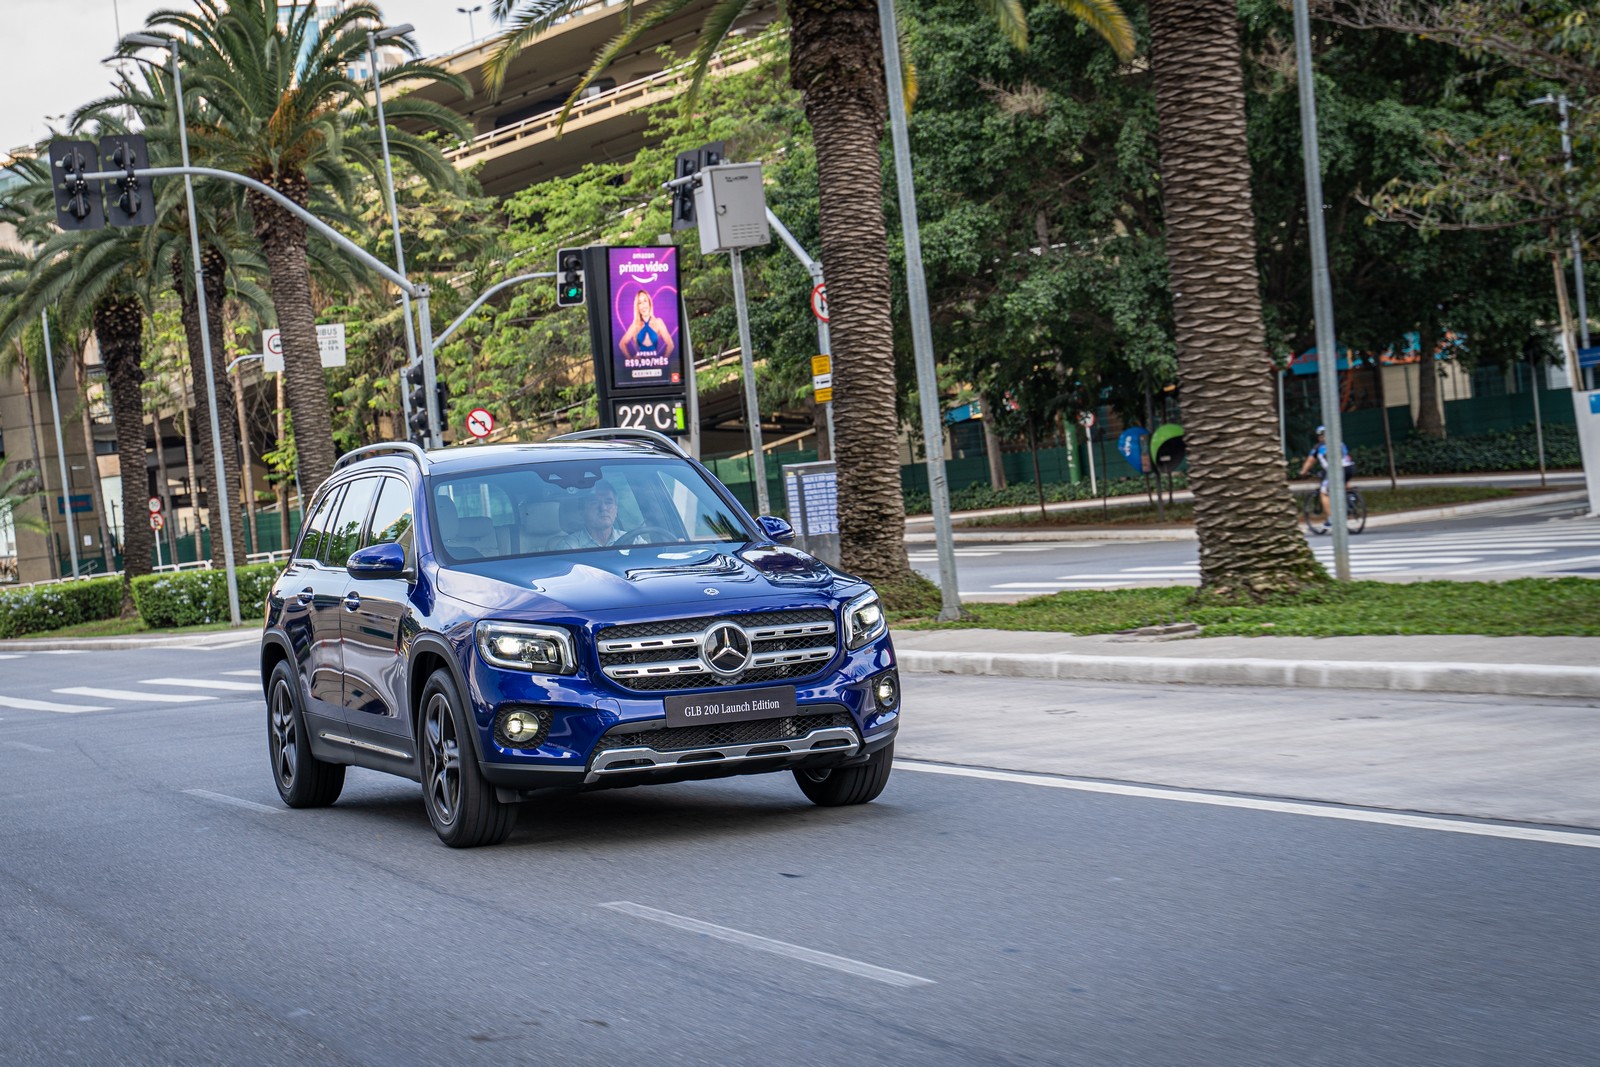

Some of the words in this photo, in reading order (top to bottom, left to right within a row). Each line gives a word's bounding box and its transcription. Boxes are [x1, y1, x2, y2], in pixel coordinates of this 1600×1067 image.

[619, 261, 644, 275] prime
[645, 260, 669, 272] video
[624, 357, 669, 367] R$9,90/MÊS
[684, 706, 702, 717] GLB
[704, 704, 720, 715] 200
[721, 701, 751, 714] Launch
[752, 699, 780, 711] Edition
